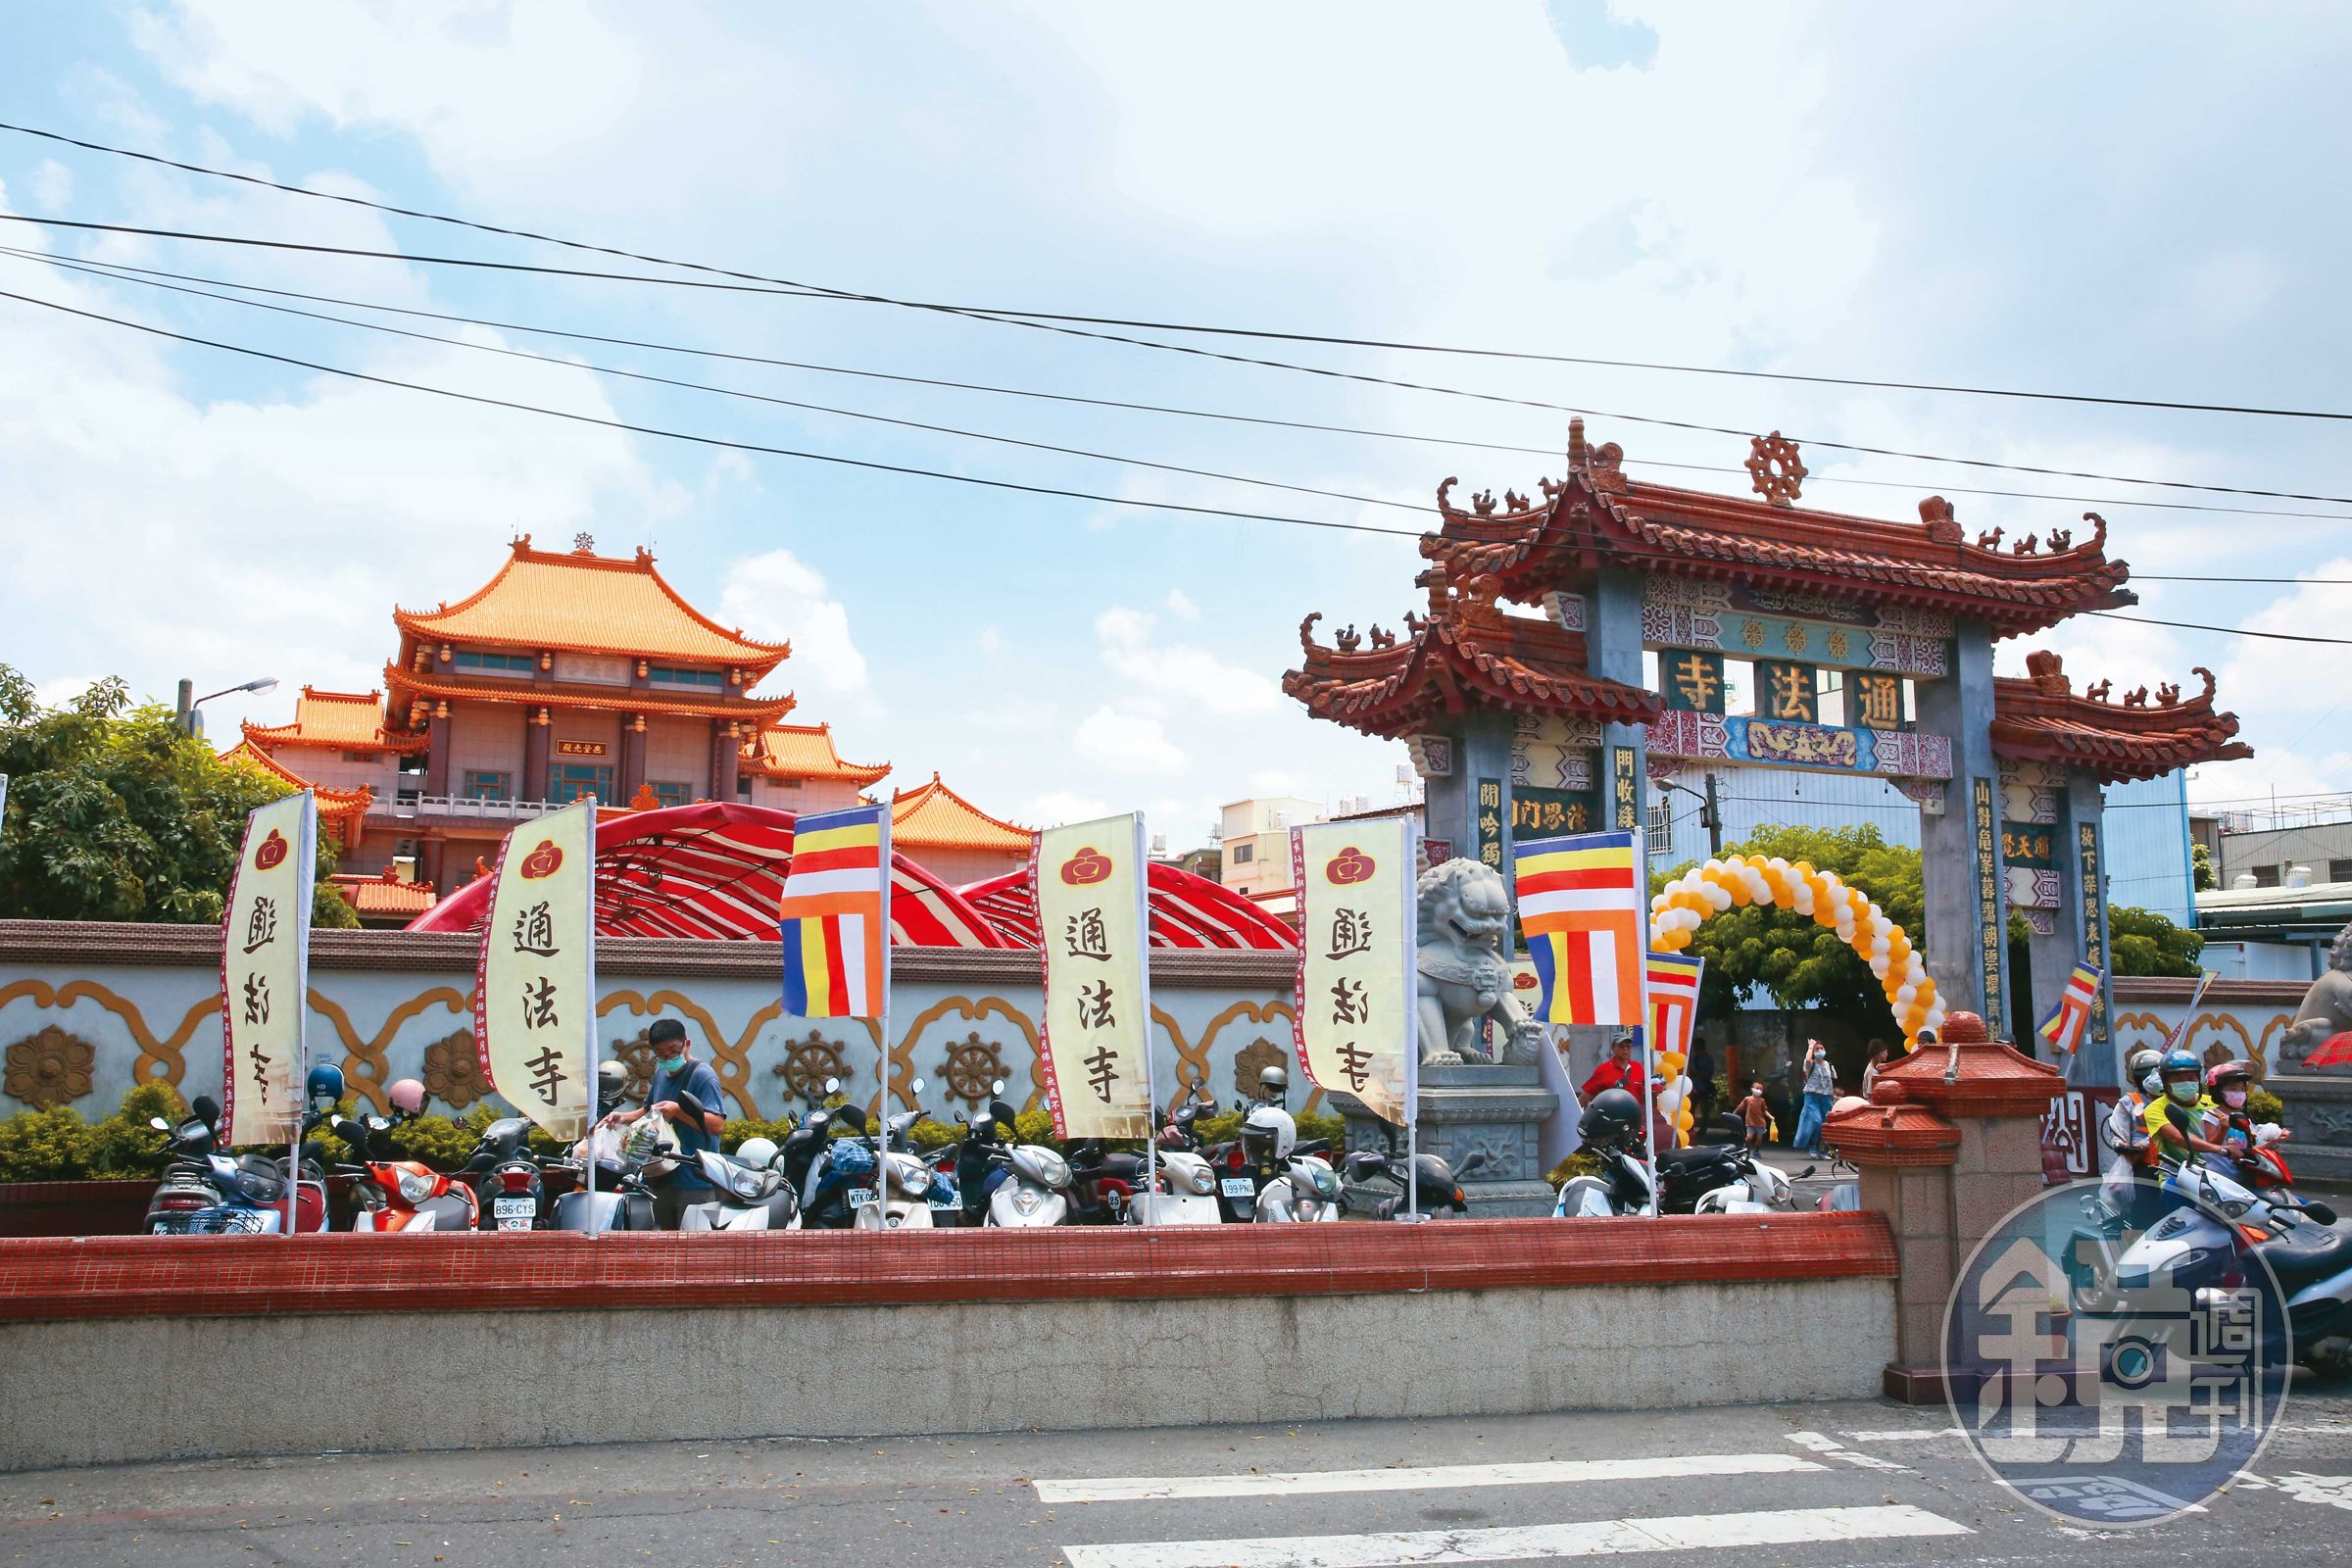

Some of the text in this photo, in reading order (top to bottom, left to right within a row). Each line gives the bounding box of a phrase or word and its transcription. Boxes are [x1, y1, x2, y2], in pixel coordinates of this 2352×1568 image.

[512, 900, 568, 1106] 通法寺
[1064, 907, 1121, 1104] 通法寺
[1108, 1196, 1119, 1206] 25
